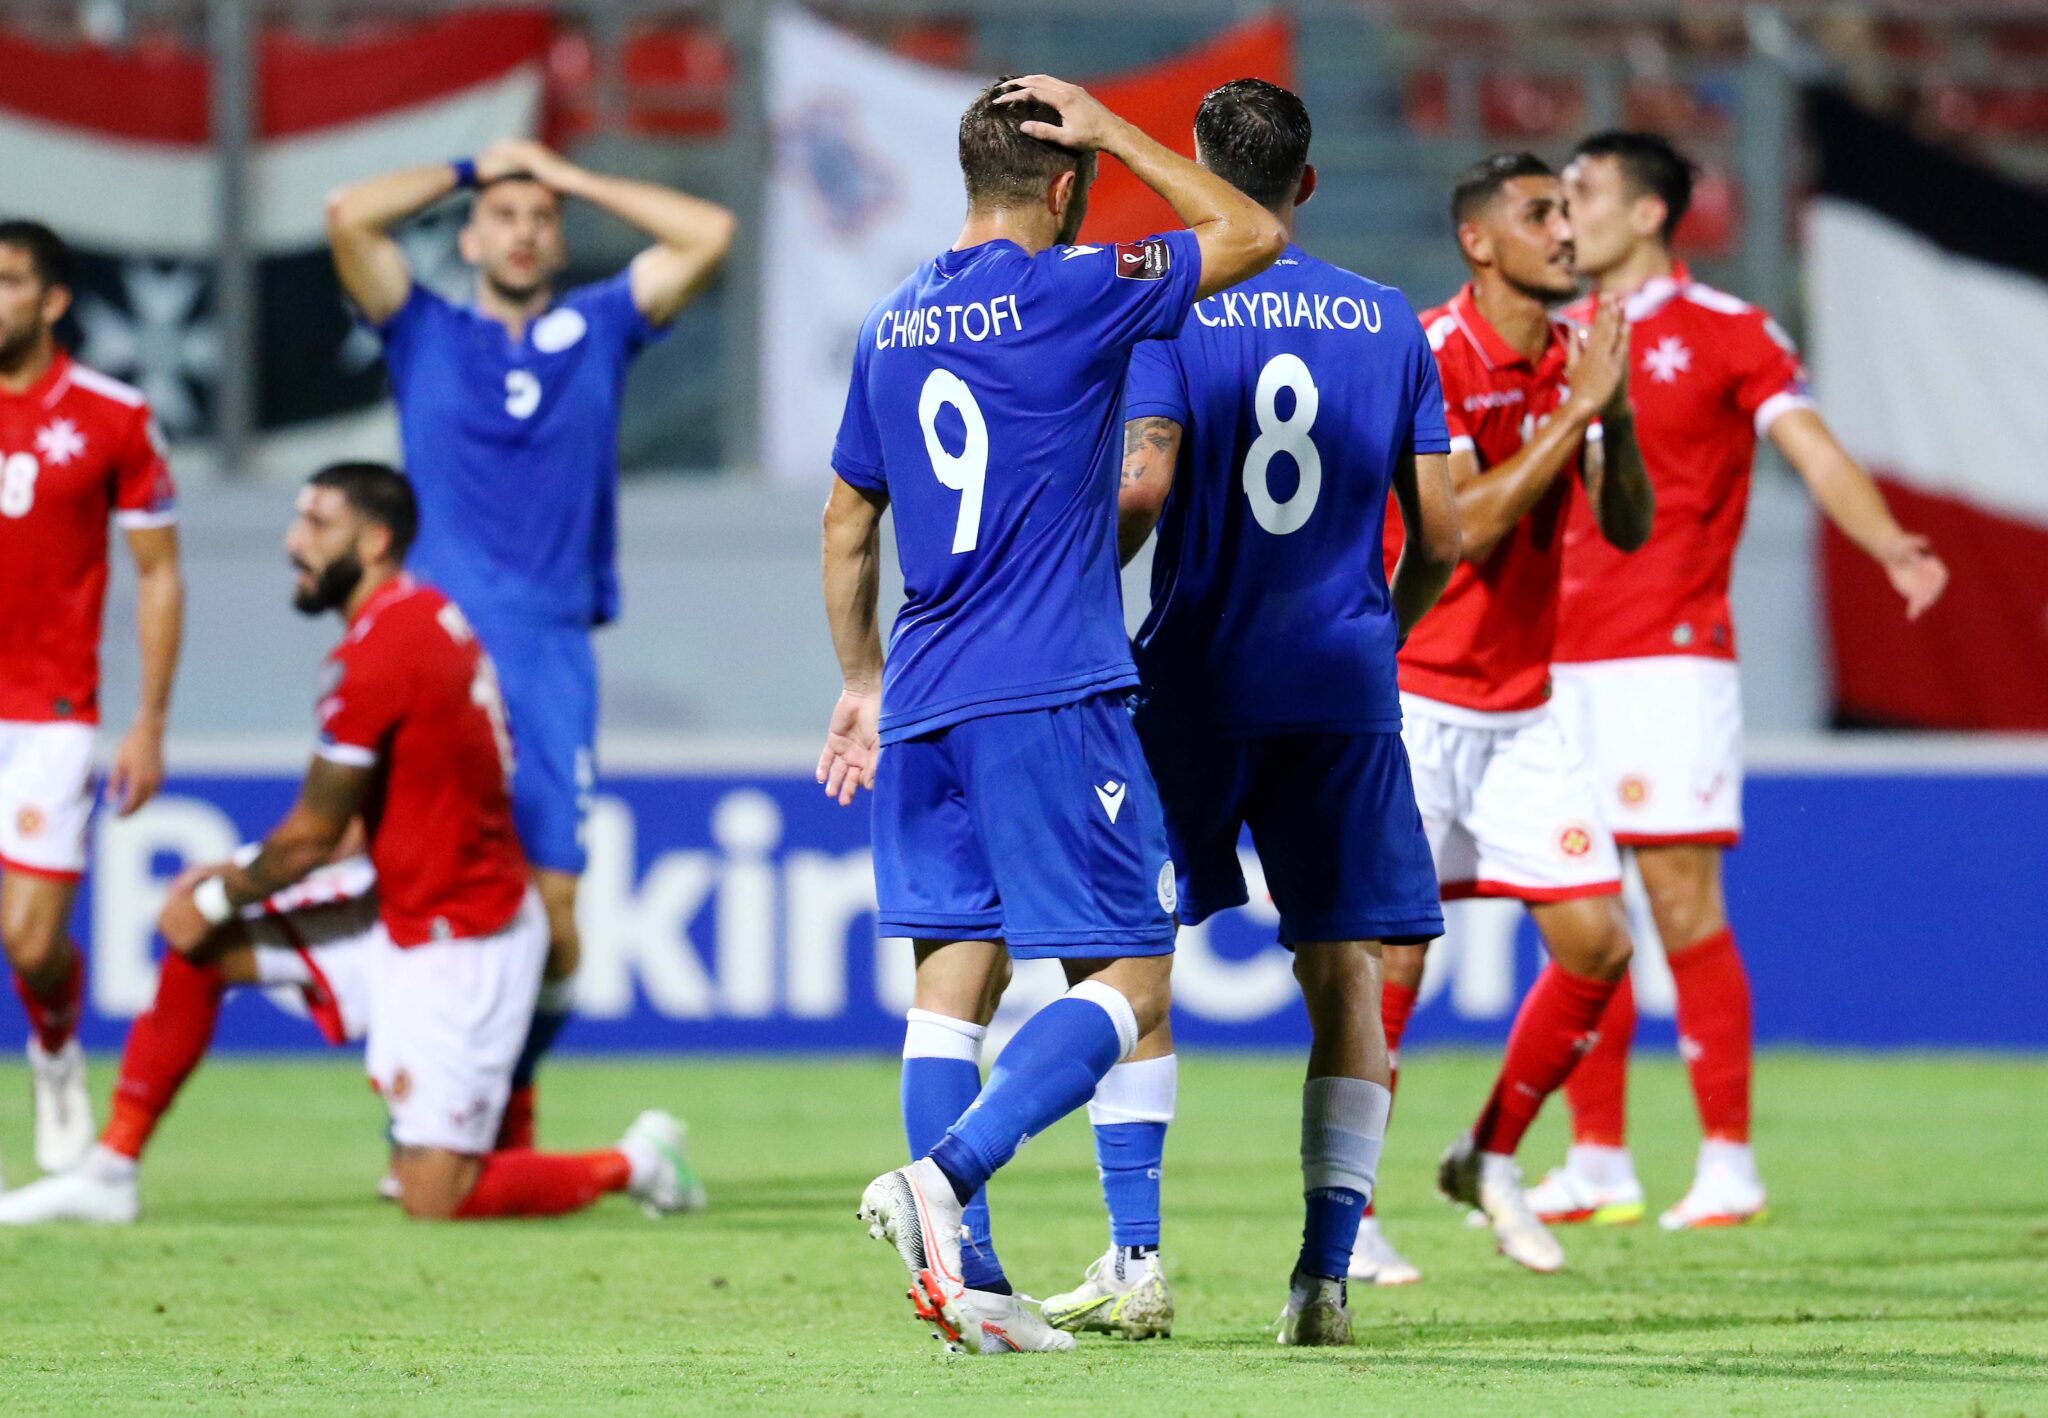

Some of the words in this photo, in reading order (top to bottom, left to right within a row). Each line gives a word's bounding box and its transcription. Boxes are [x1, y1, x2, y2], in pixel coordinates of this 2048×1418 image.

[876, 294, 1022, 350] CHRISTOFI
[1193, 291, 1382, 334] C.KYRIAKOU
[918, 369, 988, 554] 9
[1242, 354, 1322, 535] 8
[0, 449, 40, 519] 8
